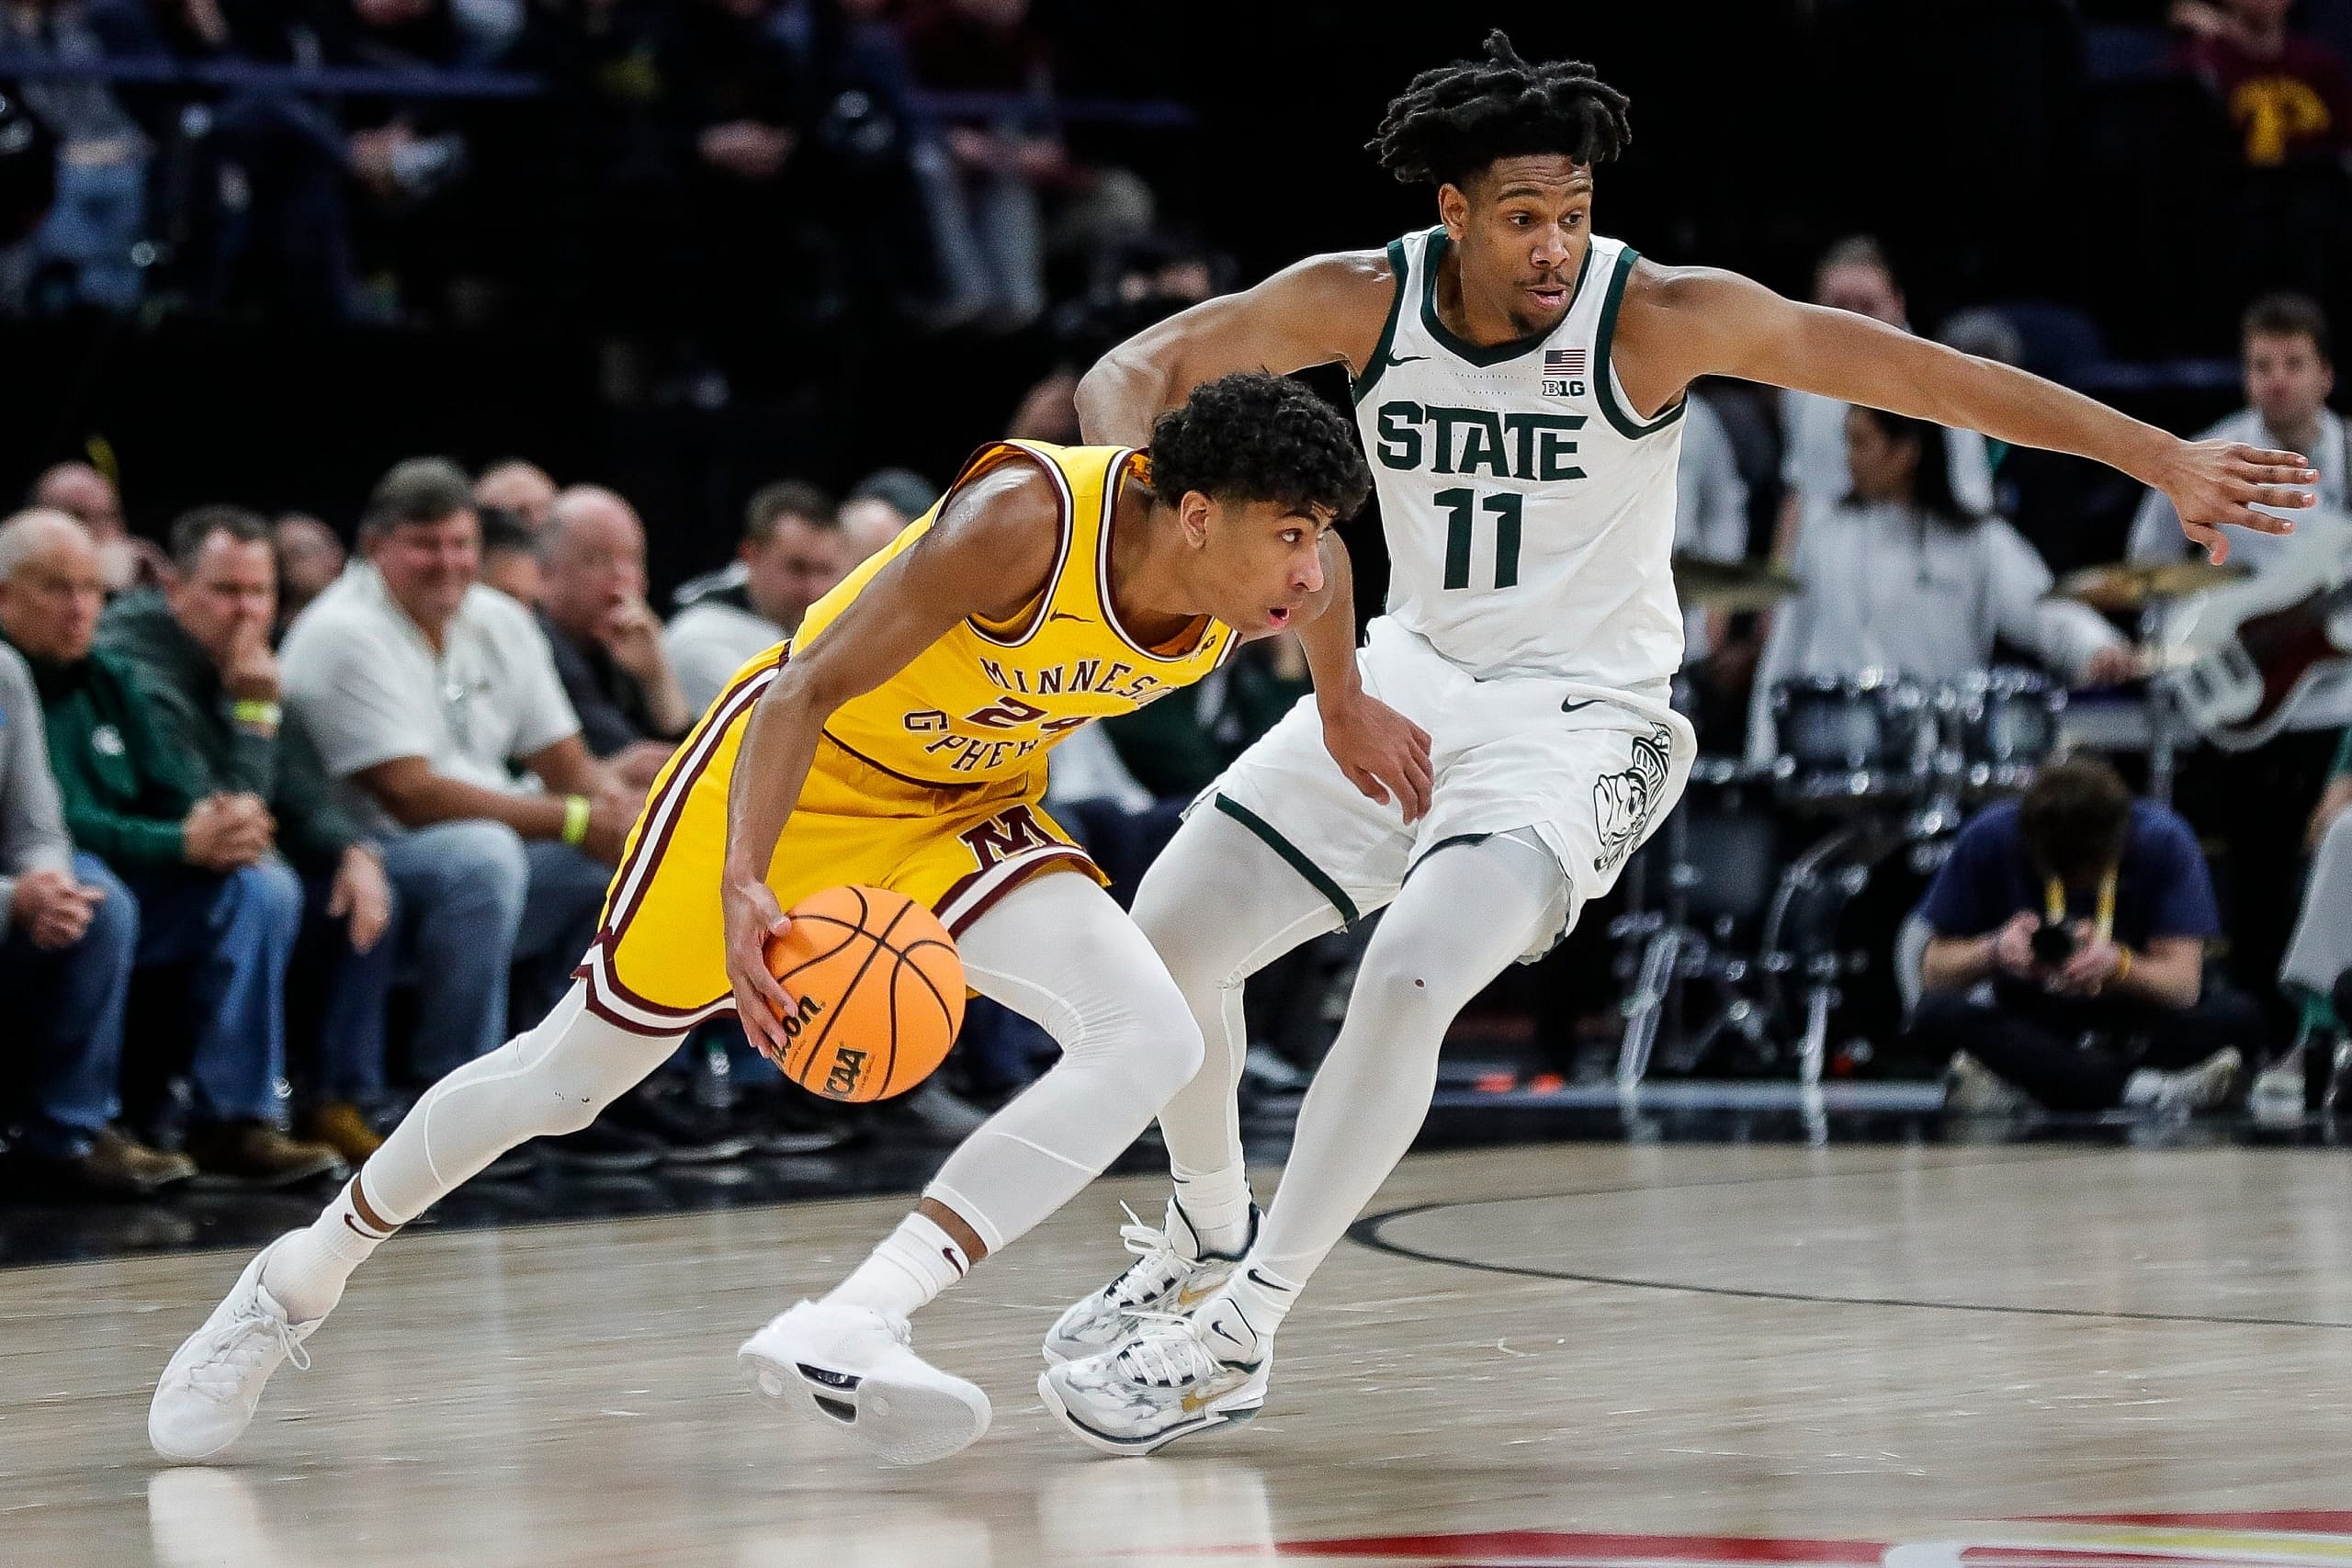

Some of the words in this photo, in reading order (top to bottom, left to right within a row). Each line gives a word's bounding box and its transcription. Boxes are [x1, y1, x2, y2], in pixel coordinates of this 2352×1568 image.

[1377, 401, 1589, 481] STATE
[1434, 488, 1523, 590] 11
[979, 657, 1179, 708] MINNES
[959, 804, 1057, 874] M
[820, 1047, 868, 1100] CAA
